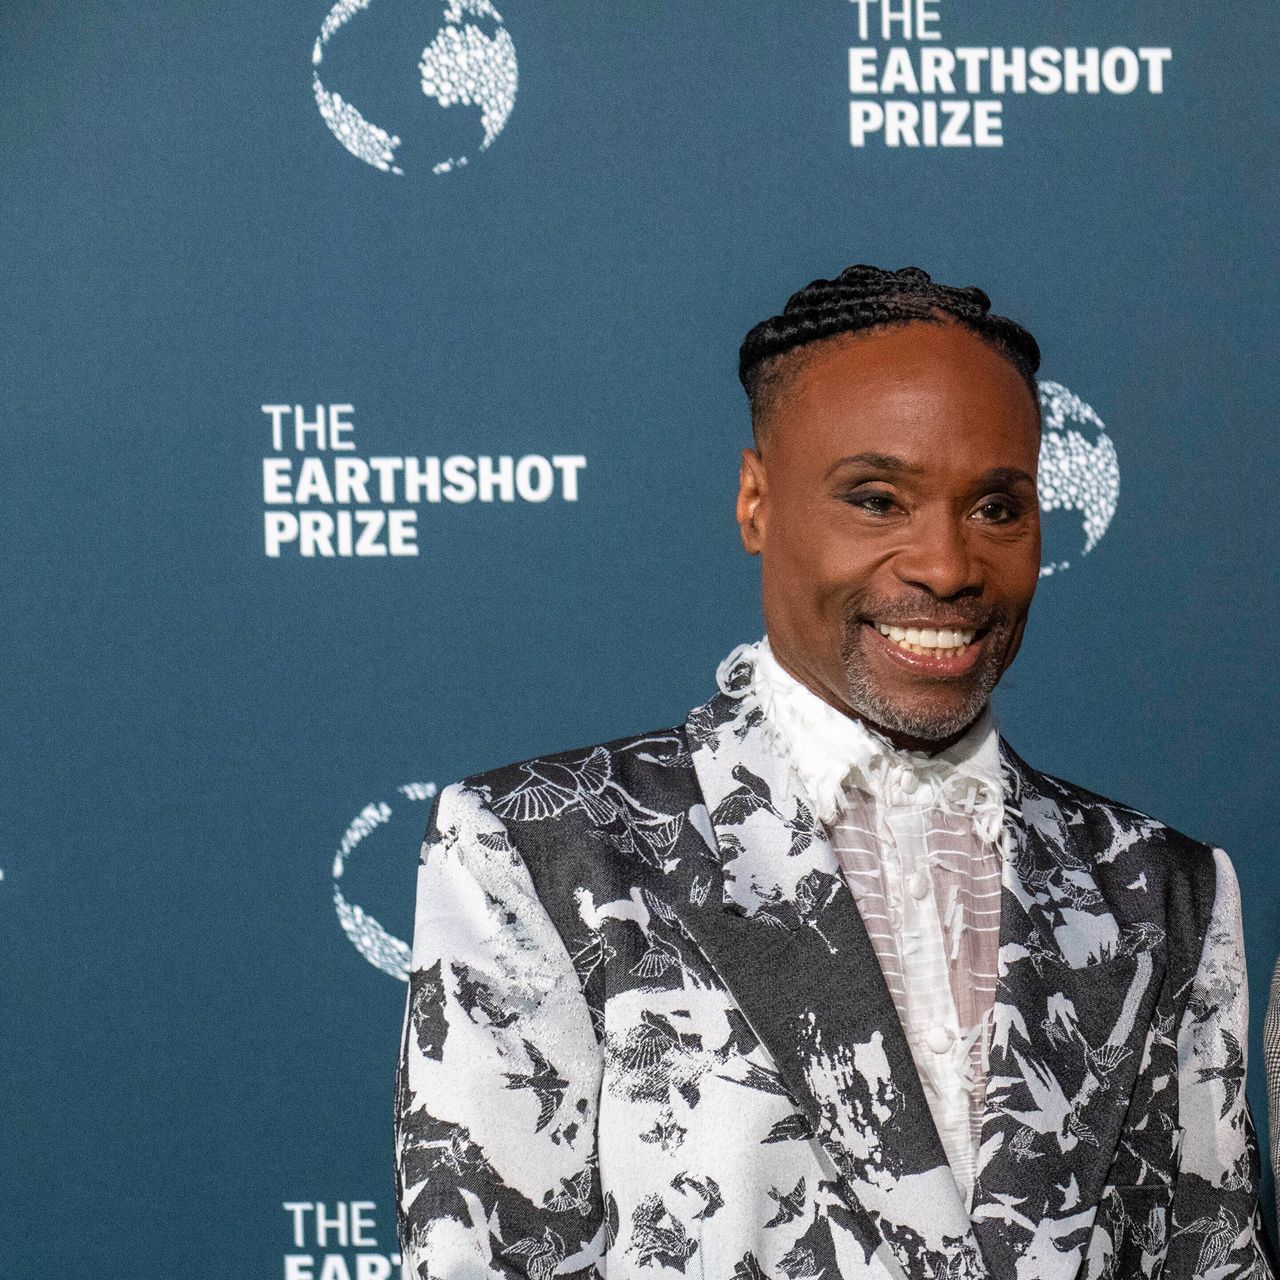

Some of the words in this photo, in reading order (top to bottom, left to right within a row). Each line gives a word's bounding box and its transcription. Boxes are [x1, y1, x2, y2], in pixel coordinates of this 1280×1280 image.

[850, 0, 941, 40] THE
[849, 46, 1172, 94] EARTHSHOT
[850, 101, 1003, 147] PRIZE
[262, 404, 355, 451] THE
[263, 455, 586, 504] EARTHSHOT
[265, 510, 419, 557] PRIZE
[283, 1201, 377, 1247] THE
